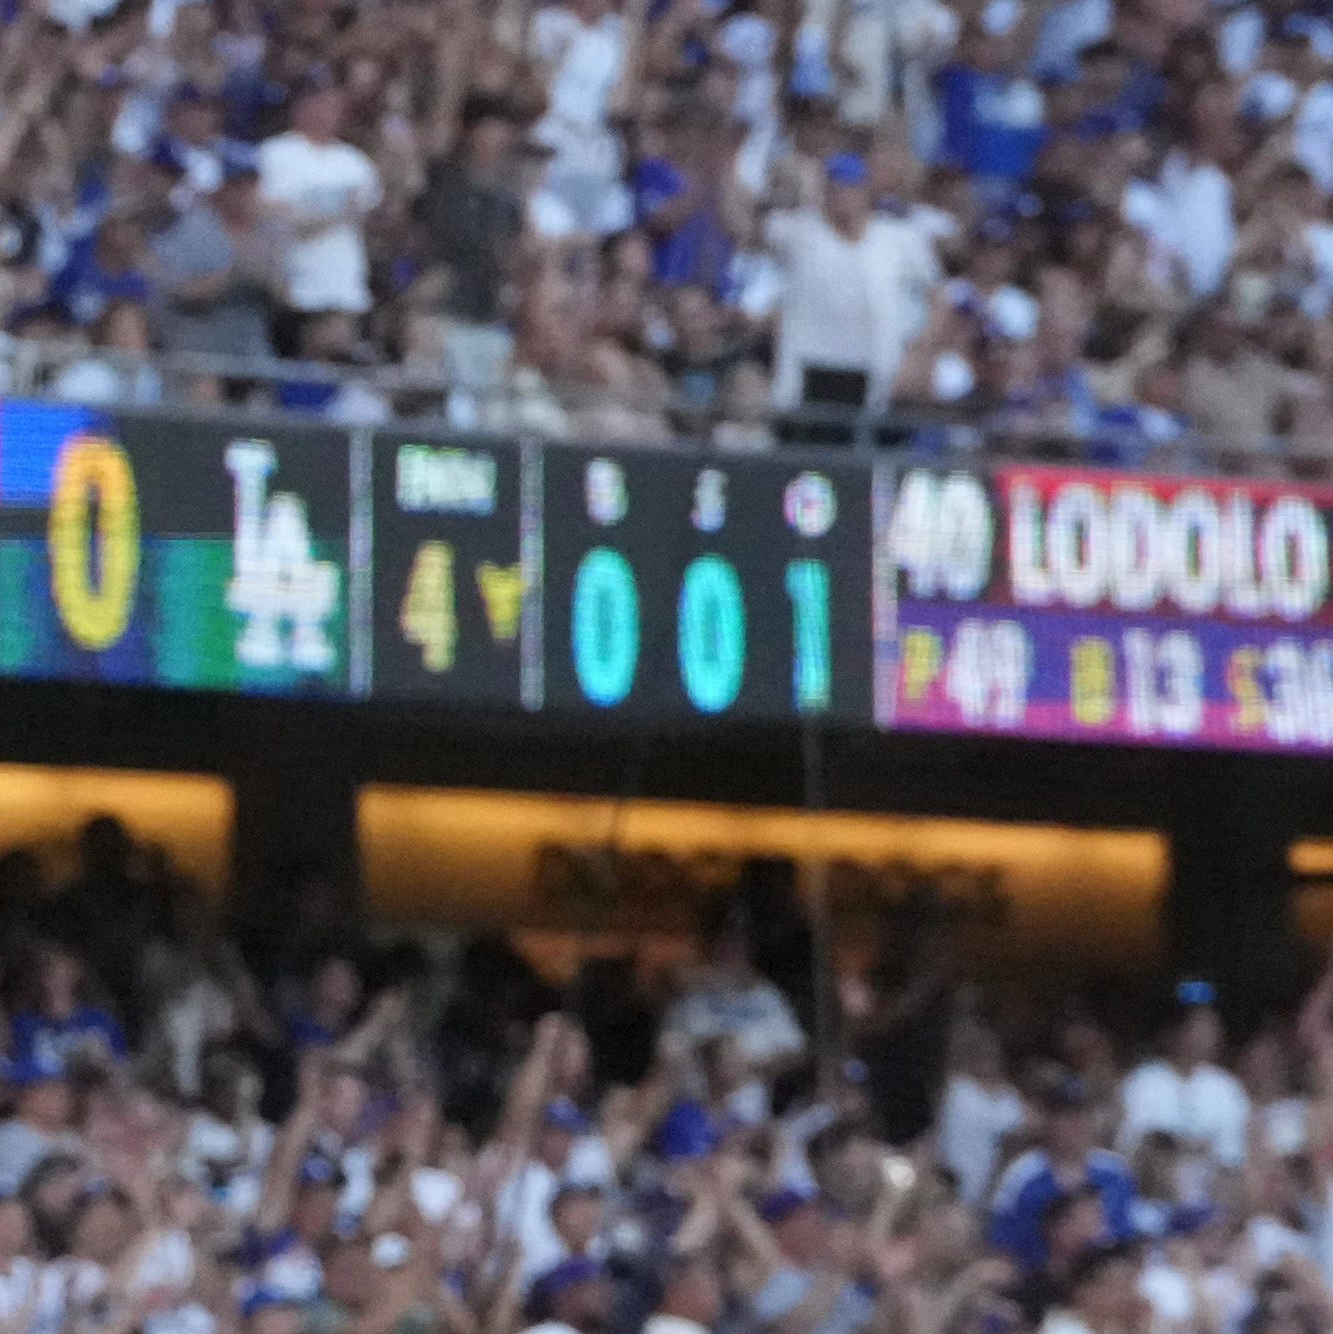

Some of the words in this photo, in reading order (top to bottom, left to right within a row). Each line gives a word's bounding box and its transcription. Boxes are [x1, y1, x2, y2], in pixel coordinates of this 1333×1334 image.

[47, 433, 139, 651] 0
[223, 439, 341, 671] LA
[400, 539, 457, 674] 4
[1008, 473, 1330, 621] LODOLO
[571, 544, 641, 709] 0
[677, 552, 746, 714] 0
[785, 558, 831, 715] 1
[1123, 628, 1203, 738] 13
